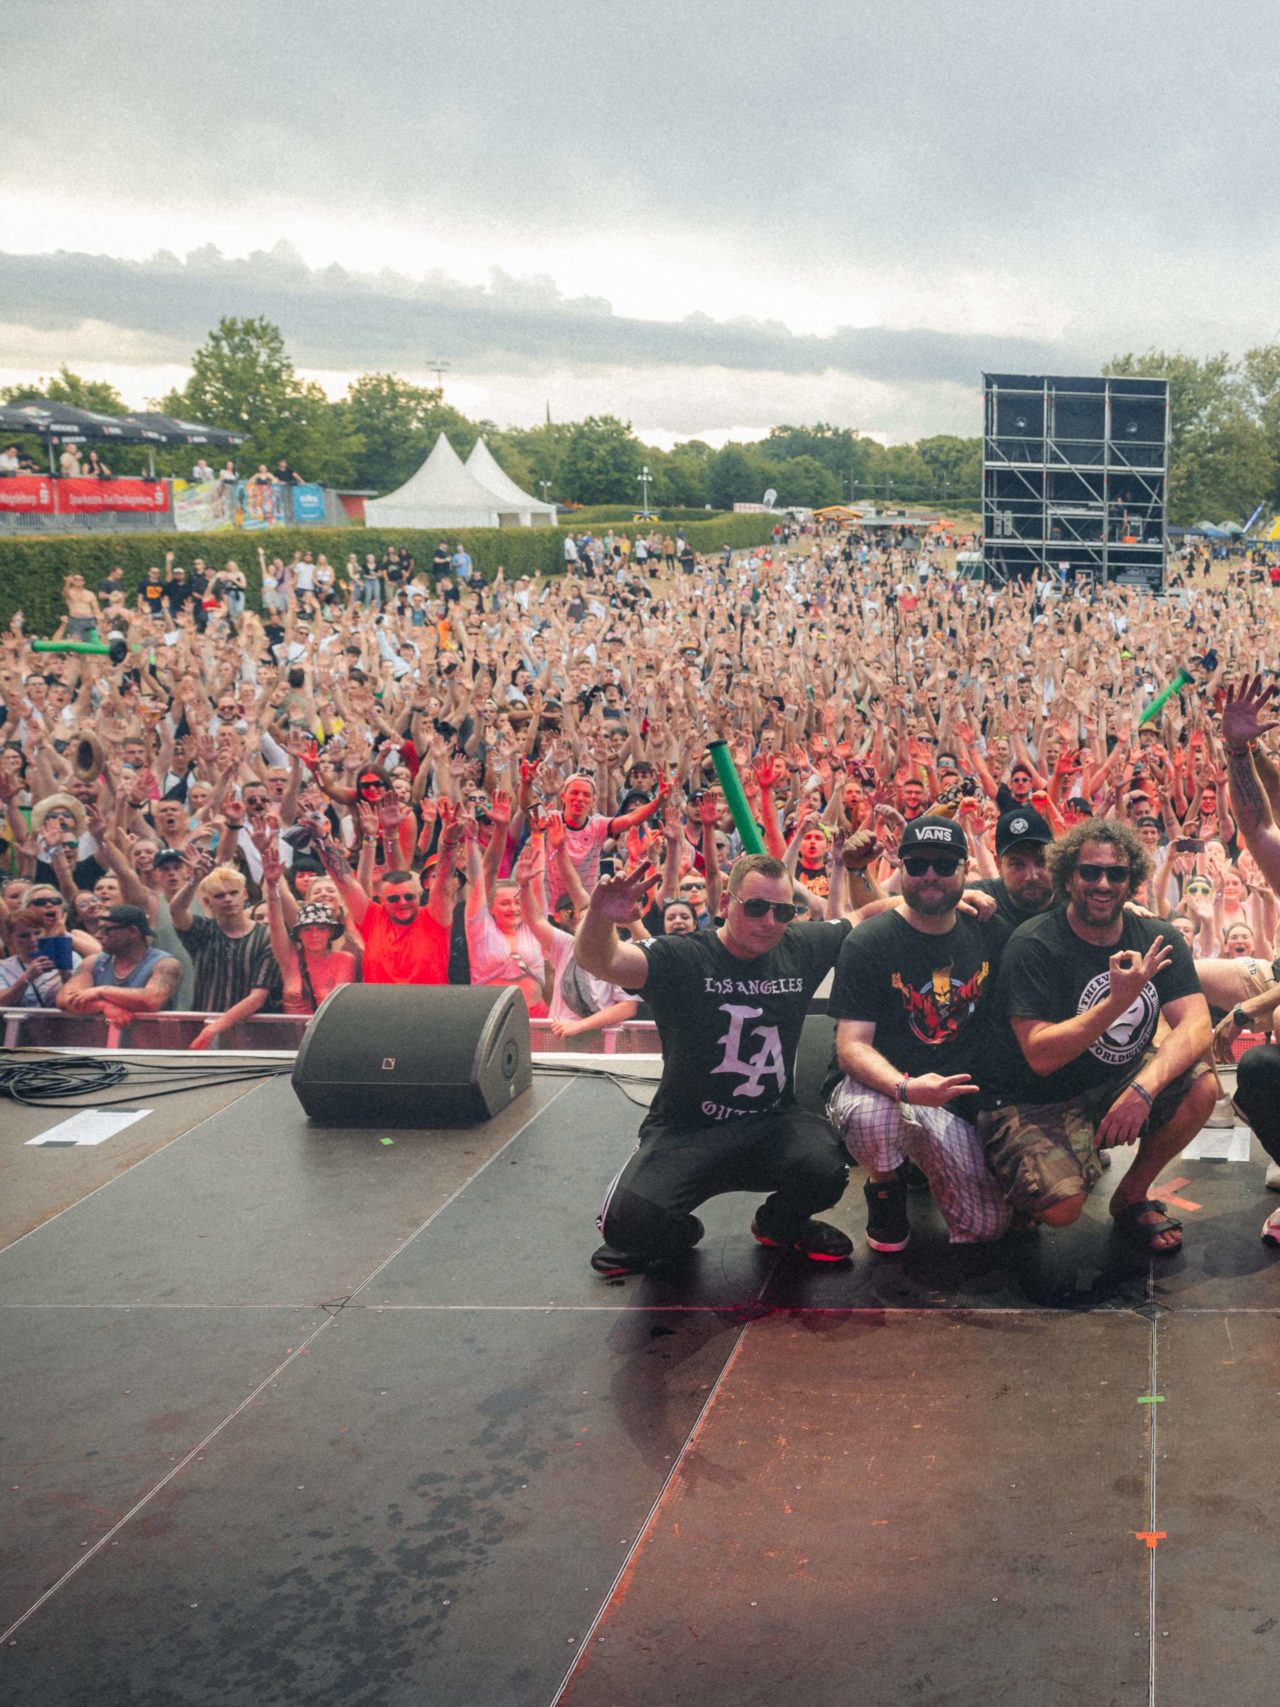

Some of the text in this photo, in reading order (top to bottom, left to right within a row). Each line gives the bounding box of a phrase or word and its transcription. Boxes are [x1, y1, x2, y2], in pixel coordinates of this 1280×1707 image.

[914, 826, 953, 841] VANS
[737, 978, 804, 995] ANGELES
[1081, 982, 1097, 1007] THE
[709, 1003, 788, 1098] LA
